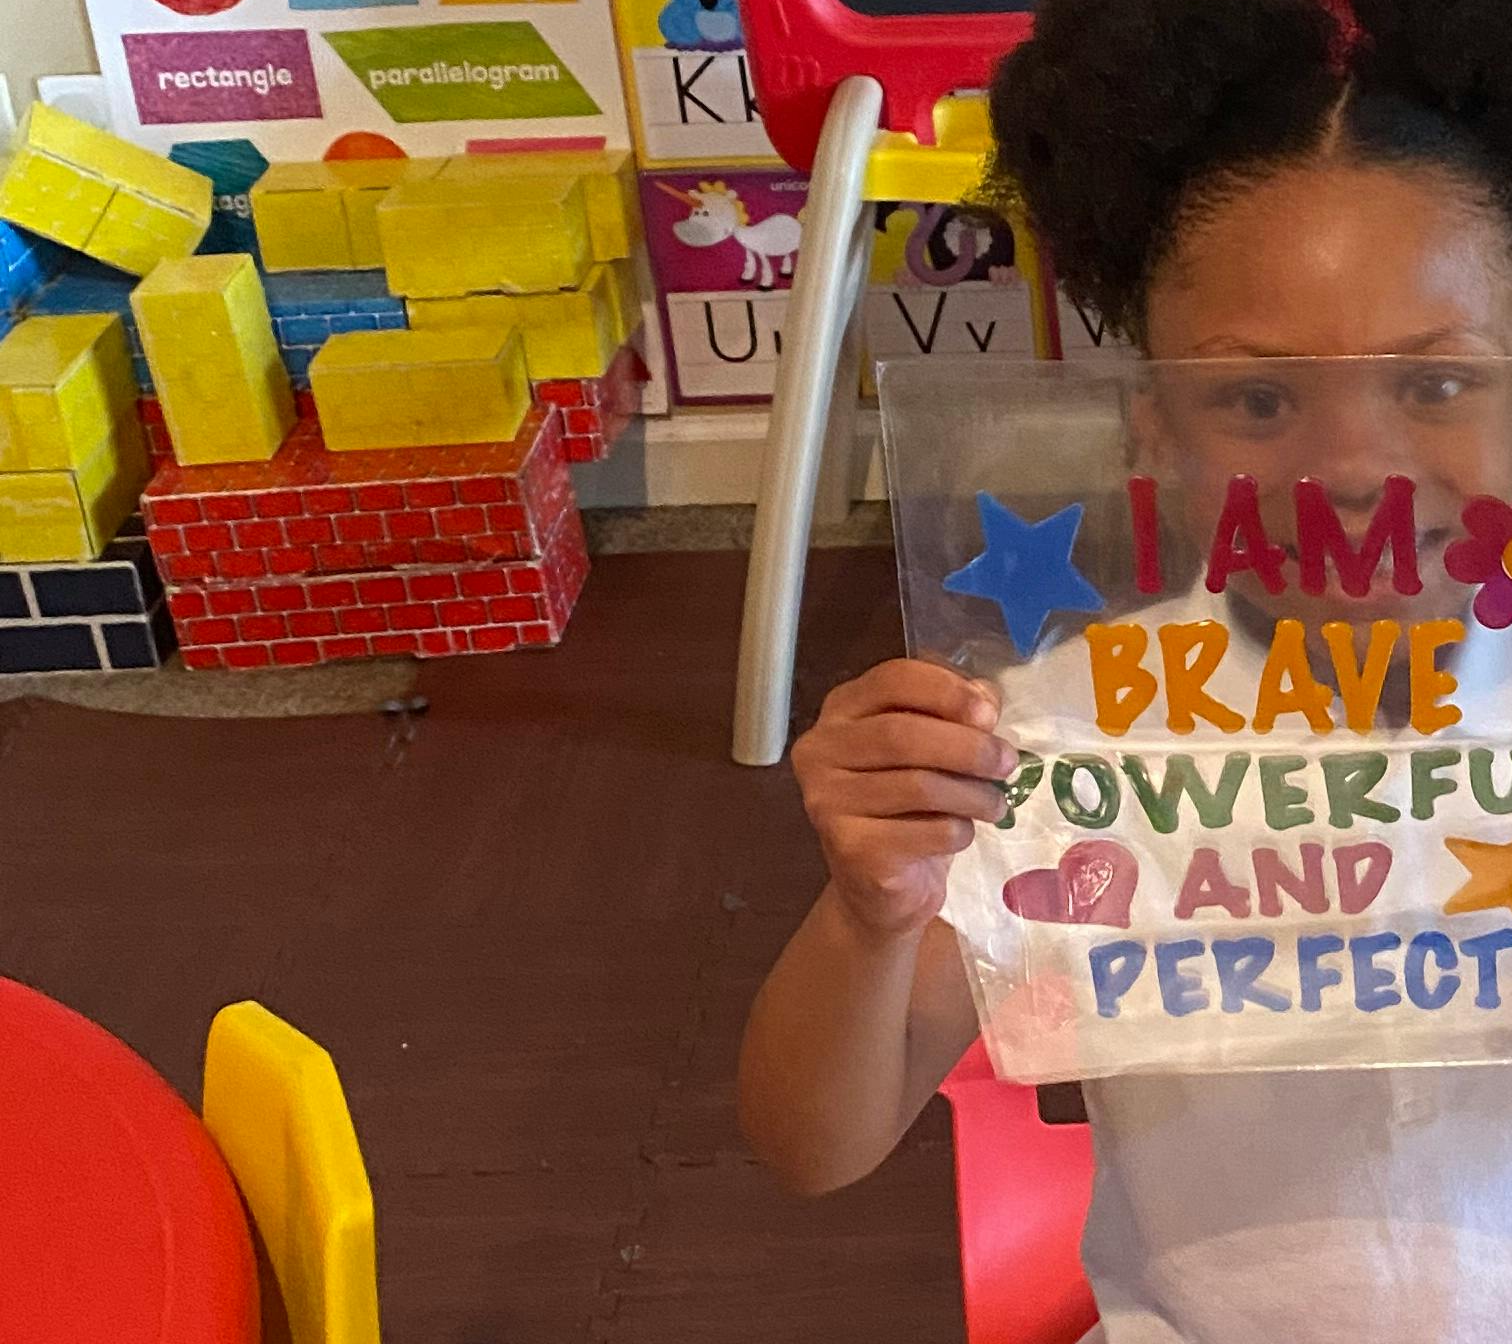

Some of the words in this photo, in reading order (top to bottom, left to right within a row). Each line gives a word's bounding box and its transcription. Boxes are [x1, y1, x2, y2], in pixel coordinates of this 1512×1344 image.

[157, 63, 293, 93] rectangle
[370, 61, 560, 91] parallelogram
[1128, 475, 1162, 594] I
[1205, 474, 1423, 597] AM
[1085, 618, 1468, 736] BRAVE
[1175, 842, 1393, 920] AND
